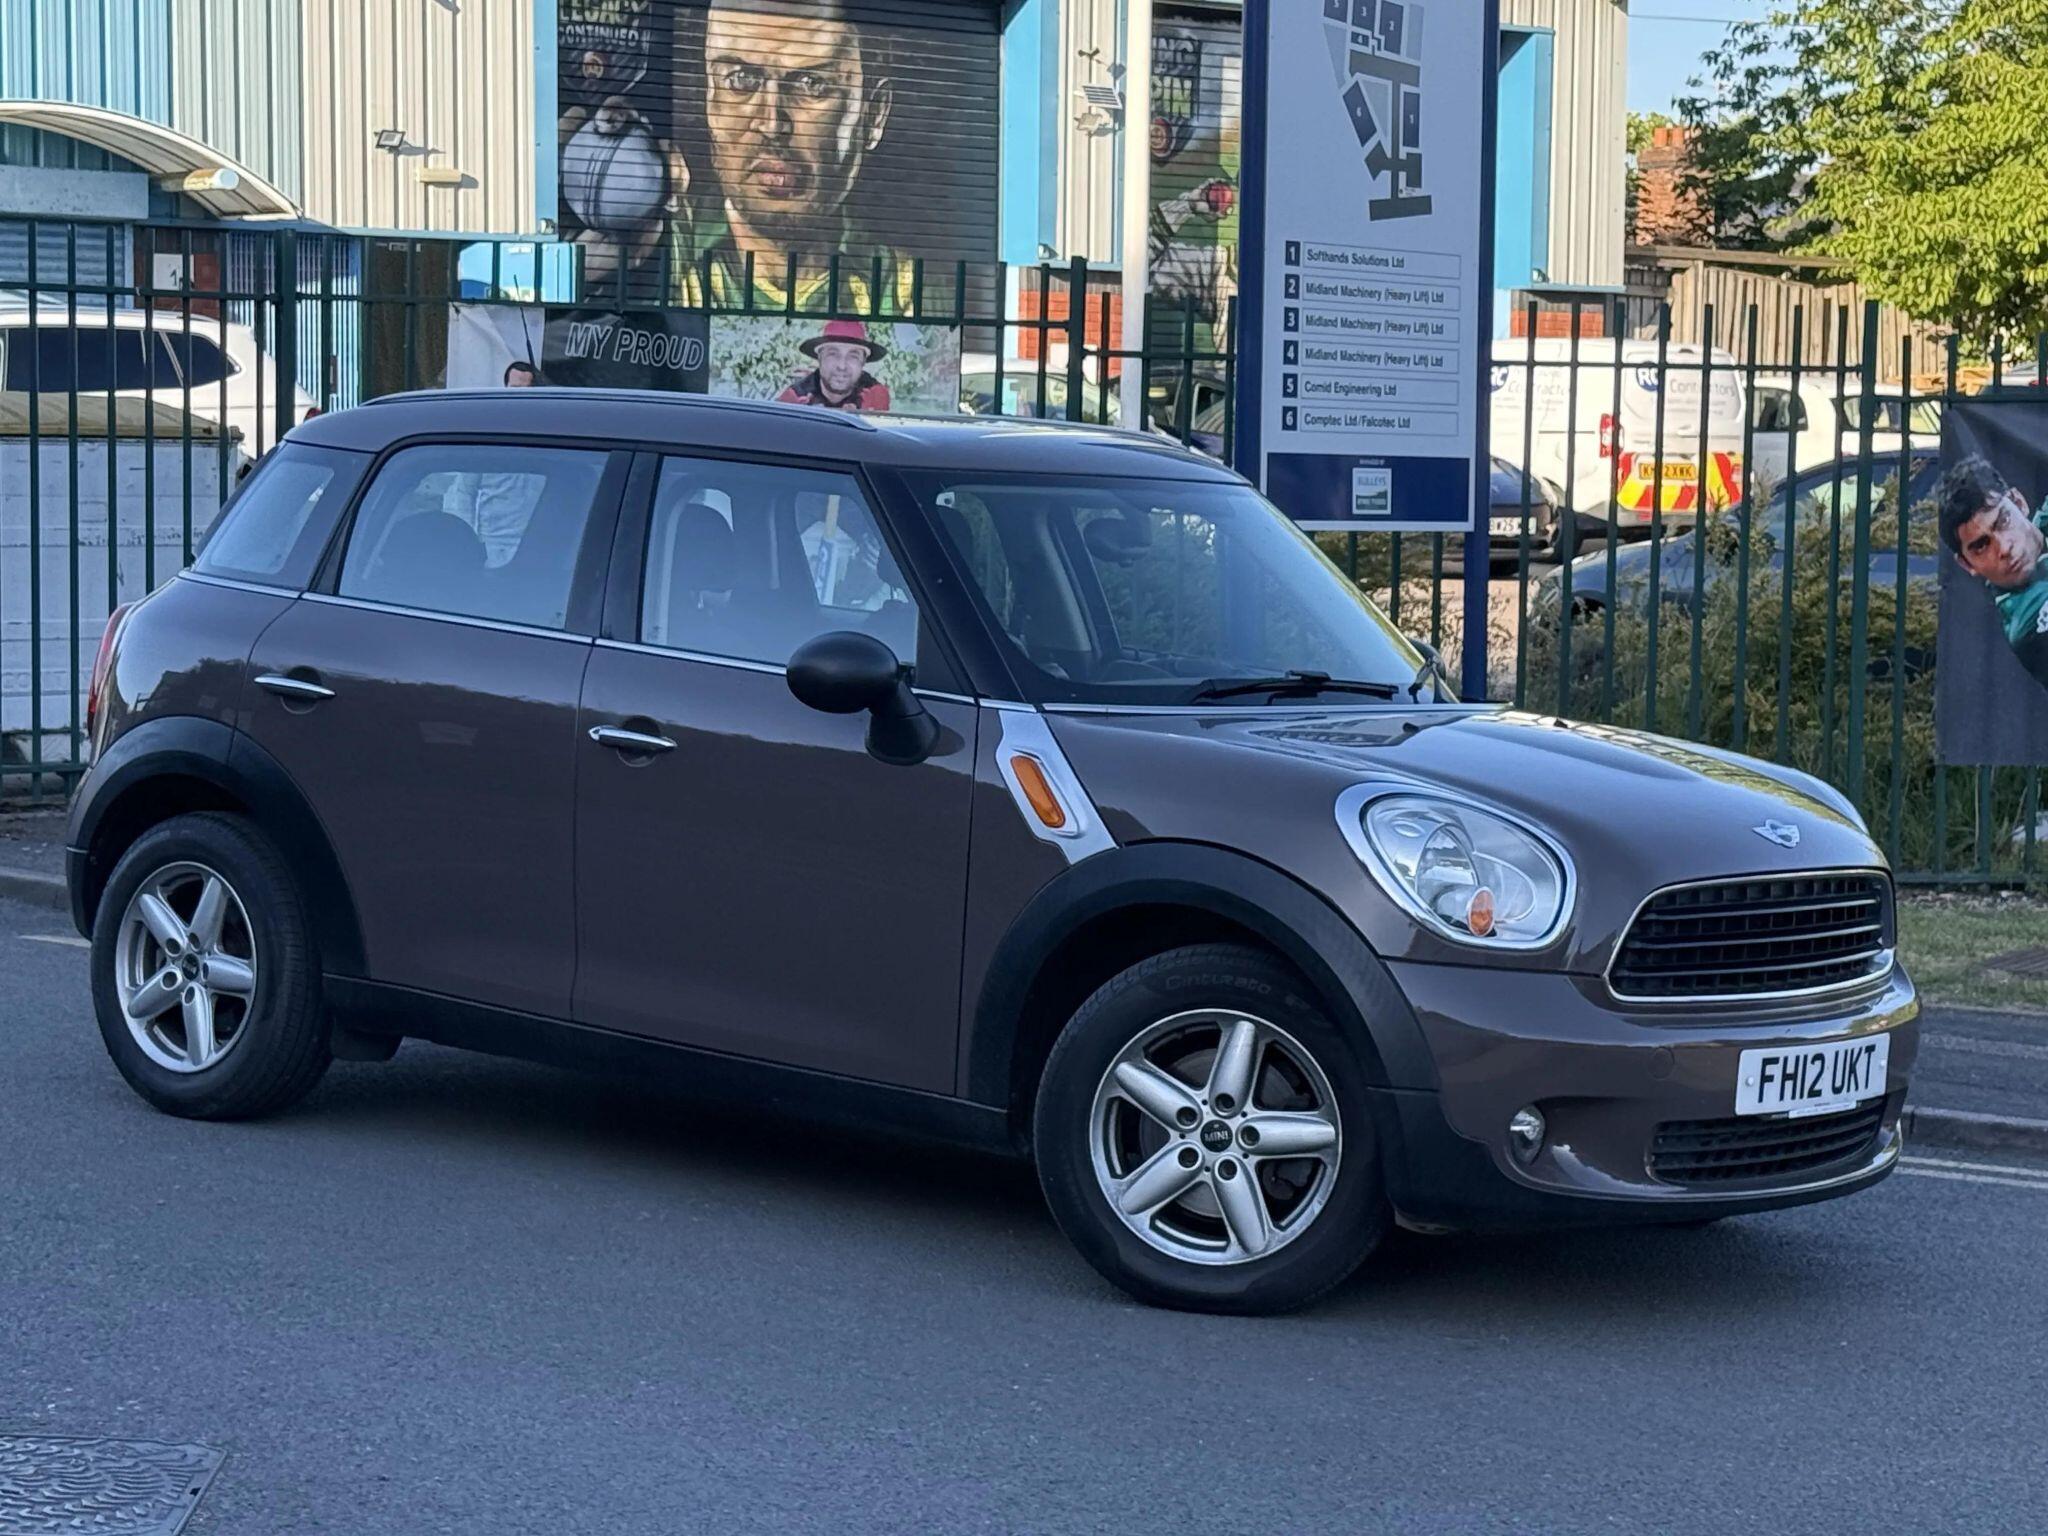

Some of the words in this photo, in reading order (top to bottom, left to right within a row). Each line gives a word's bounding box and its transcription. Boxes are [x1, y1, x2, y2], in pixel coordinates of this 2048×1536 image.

[1289, 246, 1296, 261] 1
[1307, 248, 1349, 264] Softhands
[1351, 252, 1389, 267] Solutions
[1391, 256, 1404, 268] Ltd
[1288, 279, 1296, 294] 2
[1306, 283, 1338, 296] Midland
[1340, 285, 1382, 301] Machinery
[1414, 290, 1430, 304] Lift)
[1431, 291, 1444, 303] Ltd
[1287, 312, 1295, 327] 3
[1305, 314, 1338, 328] Midland
[1340, 316, 1382, 333] Machinery
[1413, 321, 1429, 336] Lift)
[1431, 322, 1444, 334] Ltd
[565, 322, 613, 359] MY
[613, 328, 704, 370] PROUD
[1287, 344, 1295, 360] 4
[1305, 348, 1338, 361] Midland
[1340, 349, 1381, 365] Machinery
[1384, 352, 1411, 367] (Heavy
[1413, 352, 1429, 367] Lift)
[1431, 355, 1443, 367] Ltd
[1286, 378, 1294, 393] 5
[1304, 381, 1332, 393] Comid
[1334, 381, 1382, 397] Engineering
[1383, 384, 1396, 396] Ltd
[1285, 411, 1294, 426] 6
[1304, 413, 1342, 427] Comptec
[1398, 416, 1410, 428] Ltd
[1758, 1052, 1826, 1103] FH12
[1831, 1044, 1876, 1095] UKT
[1204, 1130, 1228, 1141] MINI
